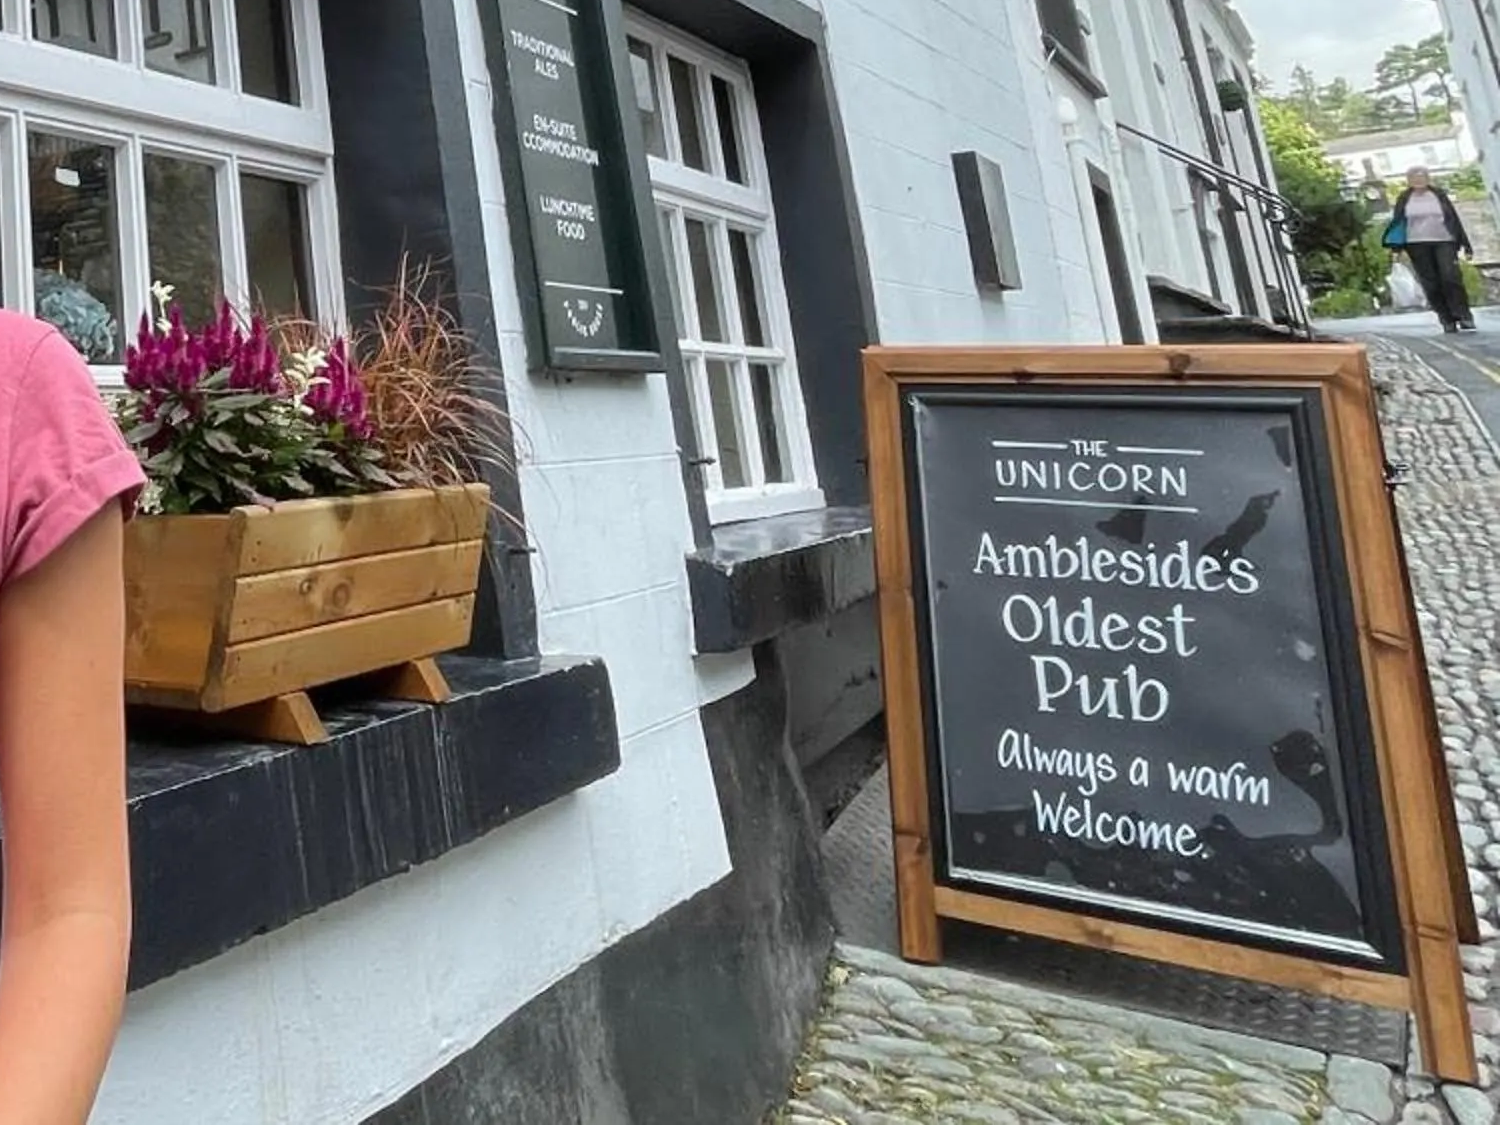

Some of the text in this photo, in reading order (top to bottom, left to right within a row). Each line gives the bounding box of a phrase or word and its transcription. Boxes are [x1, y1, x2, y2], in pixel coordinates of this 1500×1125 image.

[510, 29, 575, 67] TRADITIONAL
[535, 58, 560, 81] ALES
[533, 114, 577, 141] EN-SUITE
[539, 194, 595, 222] LUNCHTIME
[557, 219, 586, 241] FOOD
[1070, 439, 1109, 458] THE
[994, 459, 1188, 497] UNICORN
[972, 531, 1260, 594] Ambleside's
[1001, 593, 1199, 658] Oldest
[1030, 654, 1170, 723] Pub
[1128, 756, 1149, 788] a
[1167, 761, 1270, 806] warm
